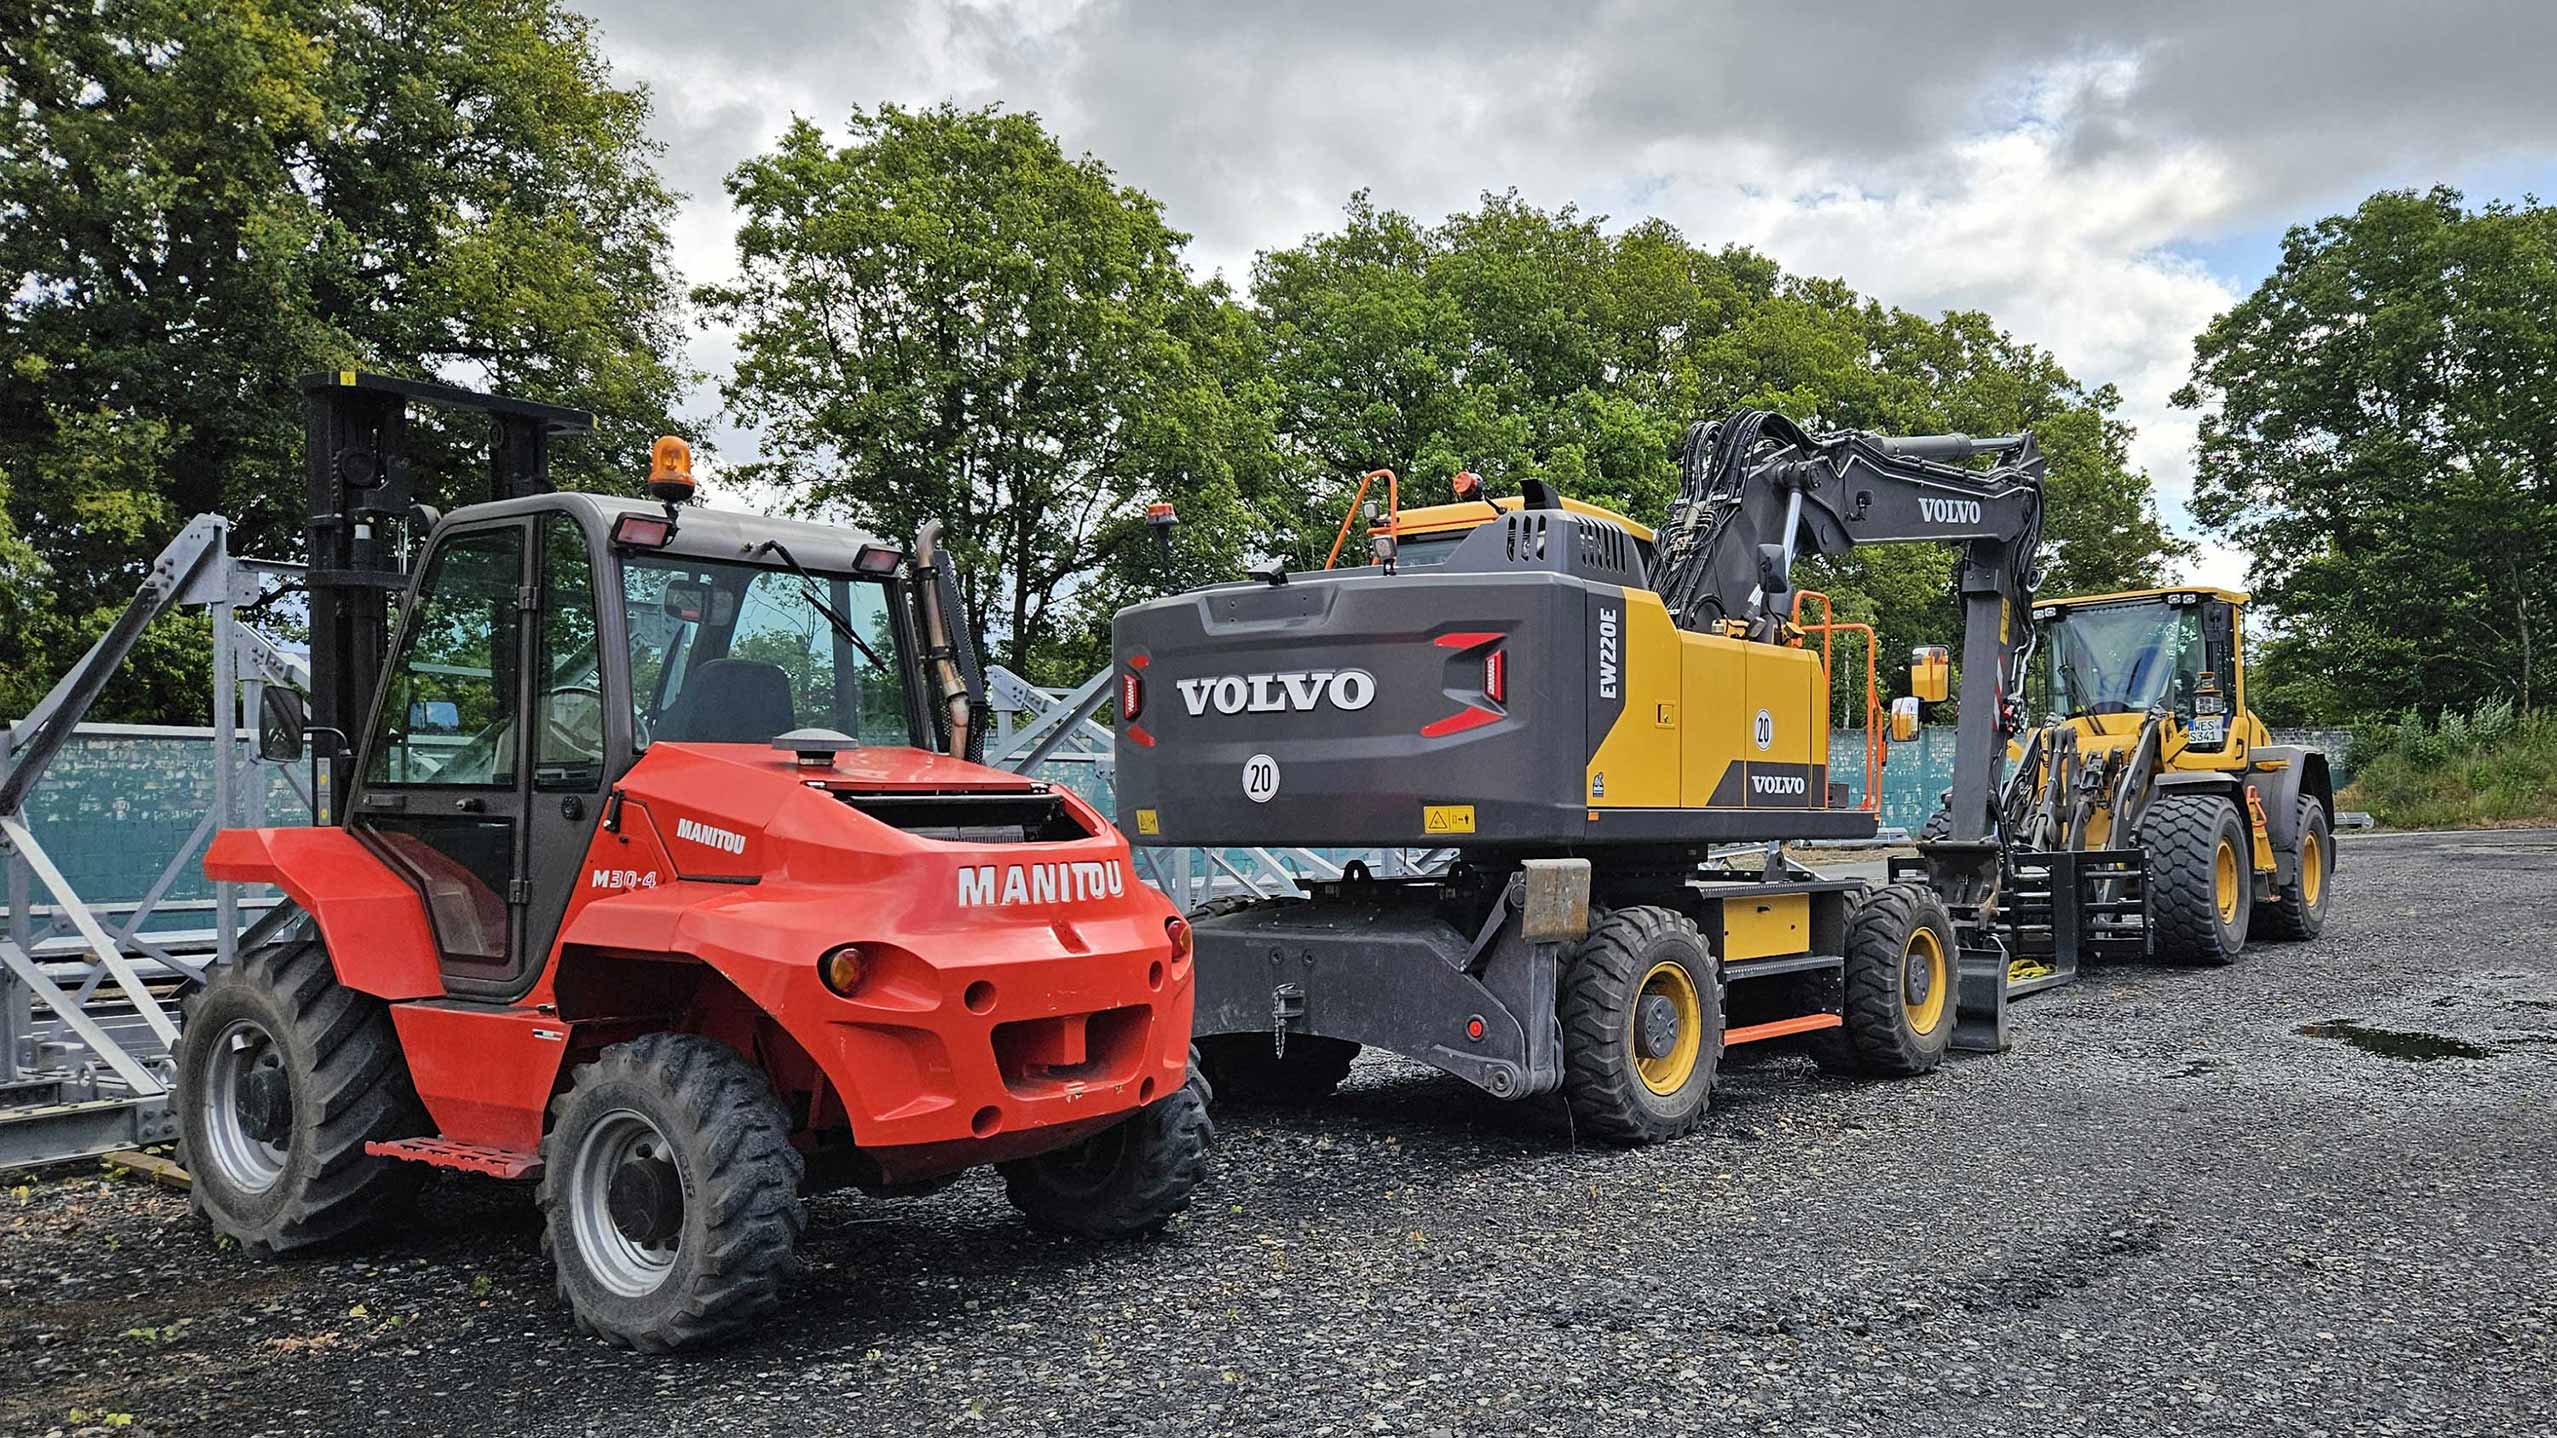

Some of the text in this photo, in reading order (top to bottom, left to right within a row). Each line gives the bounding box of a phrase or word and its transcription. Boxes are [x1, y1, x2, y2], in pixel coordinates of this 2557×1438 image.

[1918, 498, 1980, 523] VOLVO
[1600, 608, 1616, 698] EW220E
[1176, 669, 1376, 716] VOLVO
[1758, 717, 1769, 742] 20
[2190, 731, 2216, 742] S341
[1250, 764, 1271, 792] 20
[1752, 776, 1805, 794] VOLVO
[676, 818, 746, 855] MANITOU
[957, 860, 1125, 908] MANITOU
